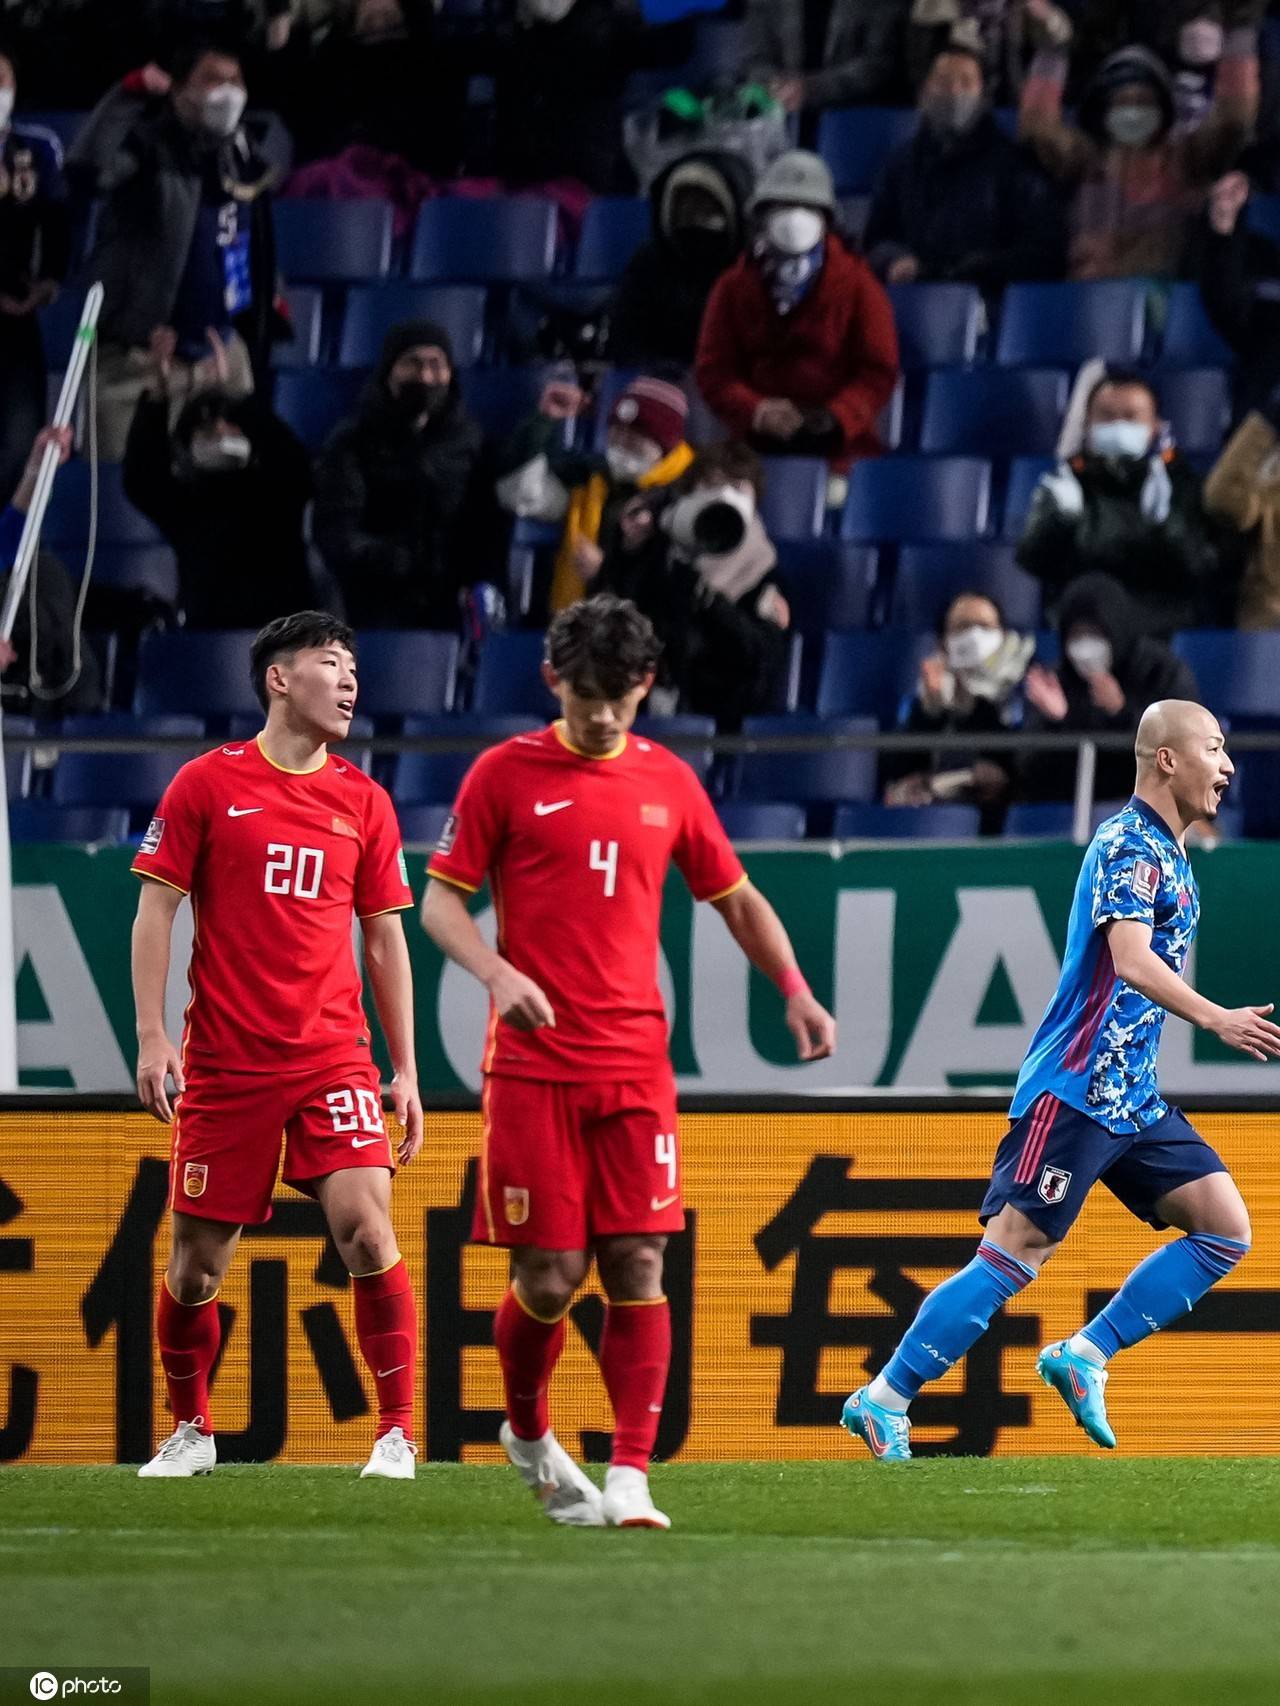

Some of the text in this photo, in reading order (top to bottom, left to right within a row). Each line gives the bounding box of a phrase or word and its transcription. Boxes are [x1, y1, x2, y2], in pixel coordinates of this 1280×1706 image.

[264, 843, 325, 899] 20
[589, 840, 618, 897] 4
[326, 1089, 384, 1133] 20
[654, 1133, 677, 1189] 4
